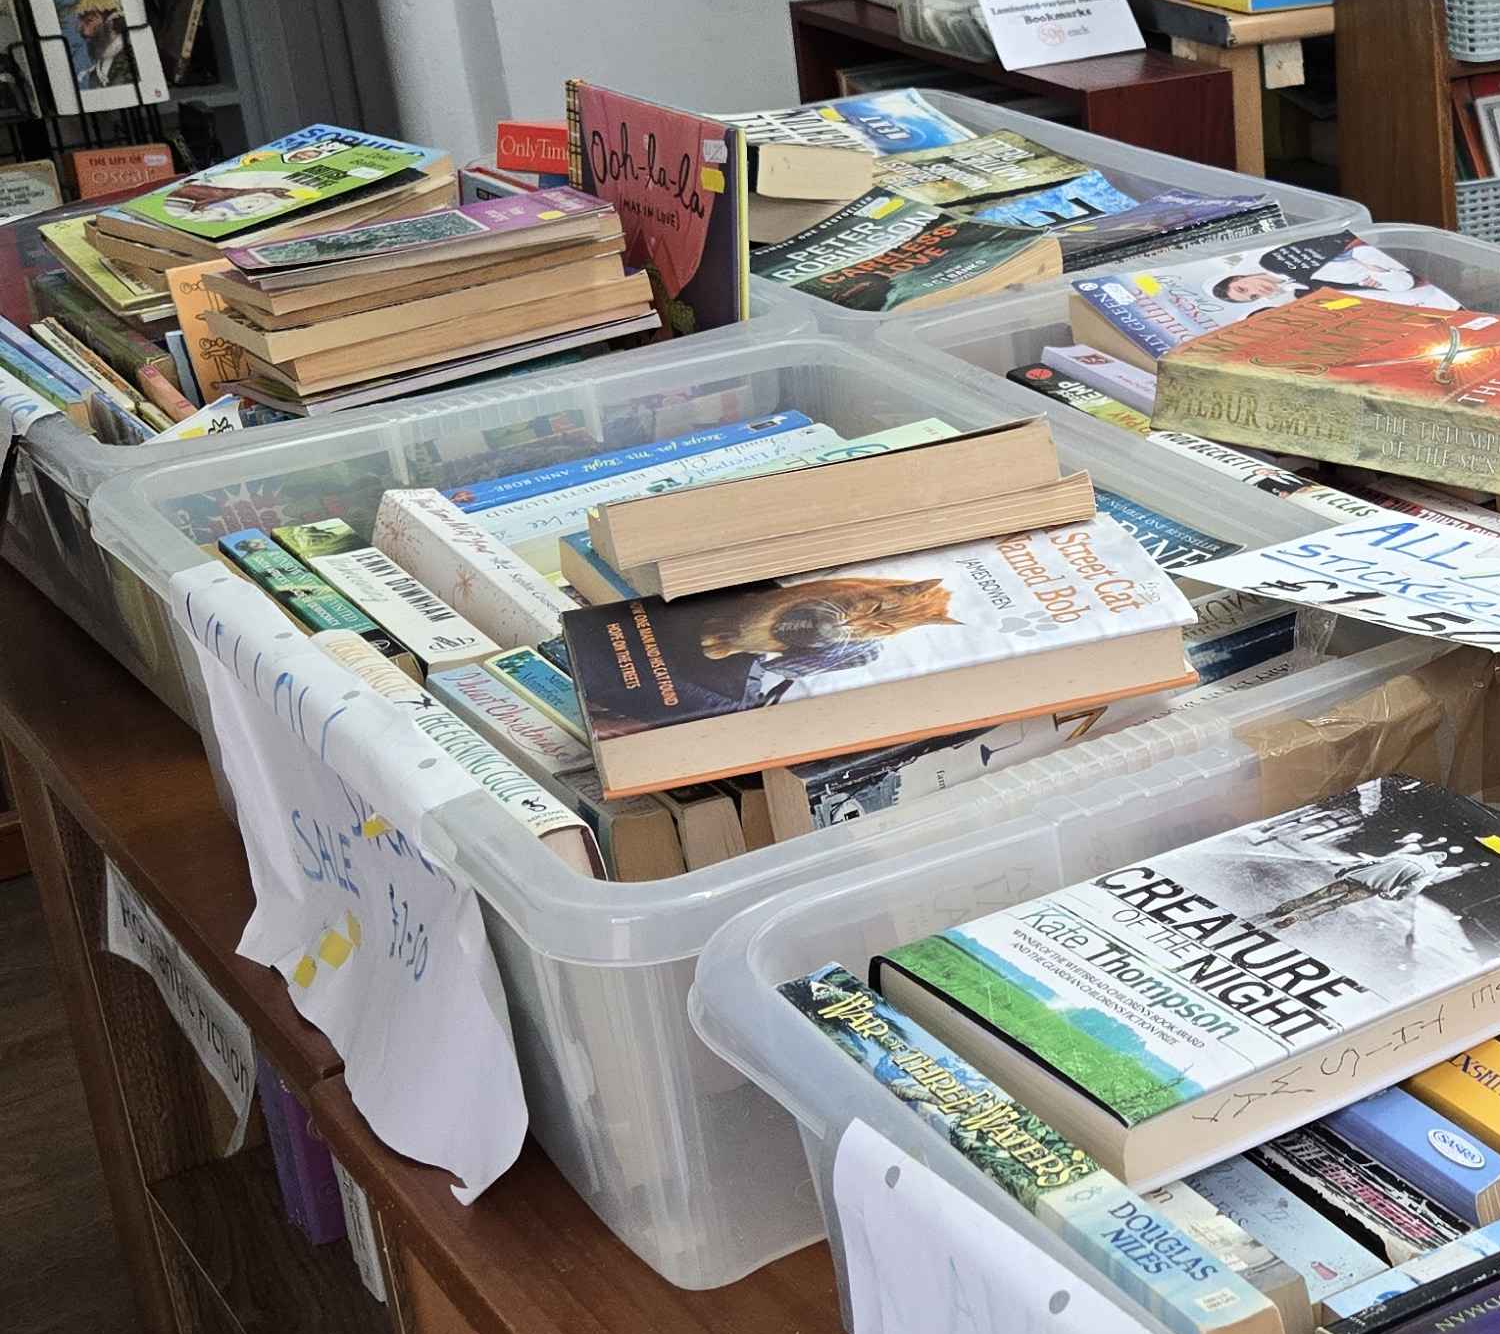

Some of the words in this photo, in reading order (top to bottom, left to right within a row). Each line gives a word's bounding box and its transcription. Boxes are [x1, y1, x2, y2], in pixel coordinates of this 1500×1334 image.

[771, 210, 934, 282] ROBINSON
[786, 220, 884, 263] PETER
[819, 225, 958, 285] CARELESS
[875, 244, 950, 279] LOVE
[1164, 387, 1261, 430] WILBUR
[1374, 413, 1409, 437] THE
[1049, 530, 1114, 583] Street
[1094, 580, 1141, 615] Cat
[1339, 522, 1474, 571] ALL
[351, 548, 389, 579] JENNY
[384, 574, 458, 625] DOWNHAM
[961, 555, 993, 585] JAMES
[979, 583, 1017, 612] BOWEN
[1035, 584, 1090, 626] Bob
[1091, 864, 1370, 1011] CREATURE
[1027, 905, 1086, 950] Kate
[1088, 941, 1239, 1041] Thompson
[1146, 925, 1191, 963] THE
[1192, 957, 1340, 1046] NIGHT
[818, 992, 884, 1041] WAR
[896, 1051, 981, 1117] THREE
[960, 1102, 1087, 1187] WATERS
[1101, 1225, 1176, 1275] NILES
[1110, 1200, 1219, 1284] DOUGLAS
